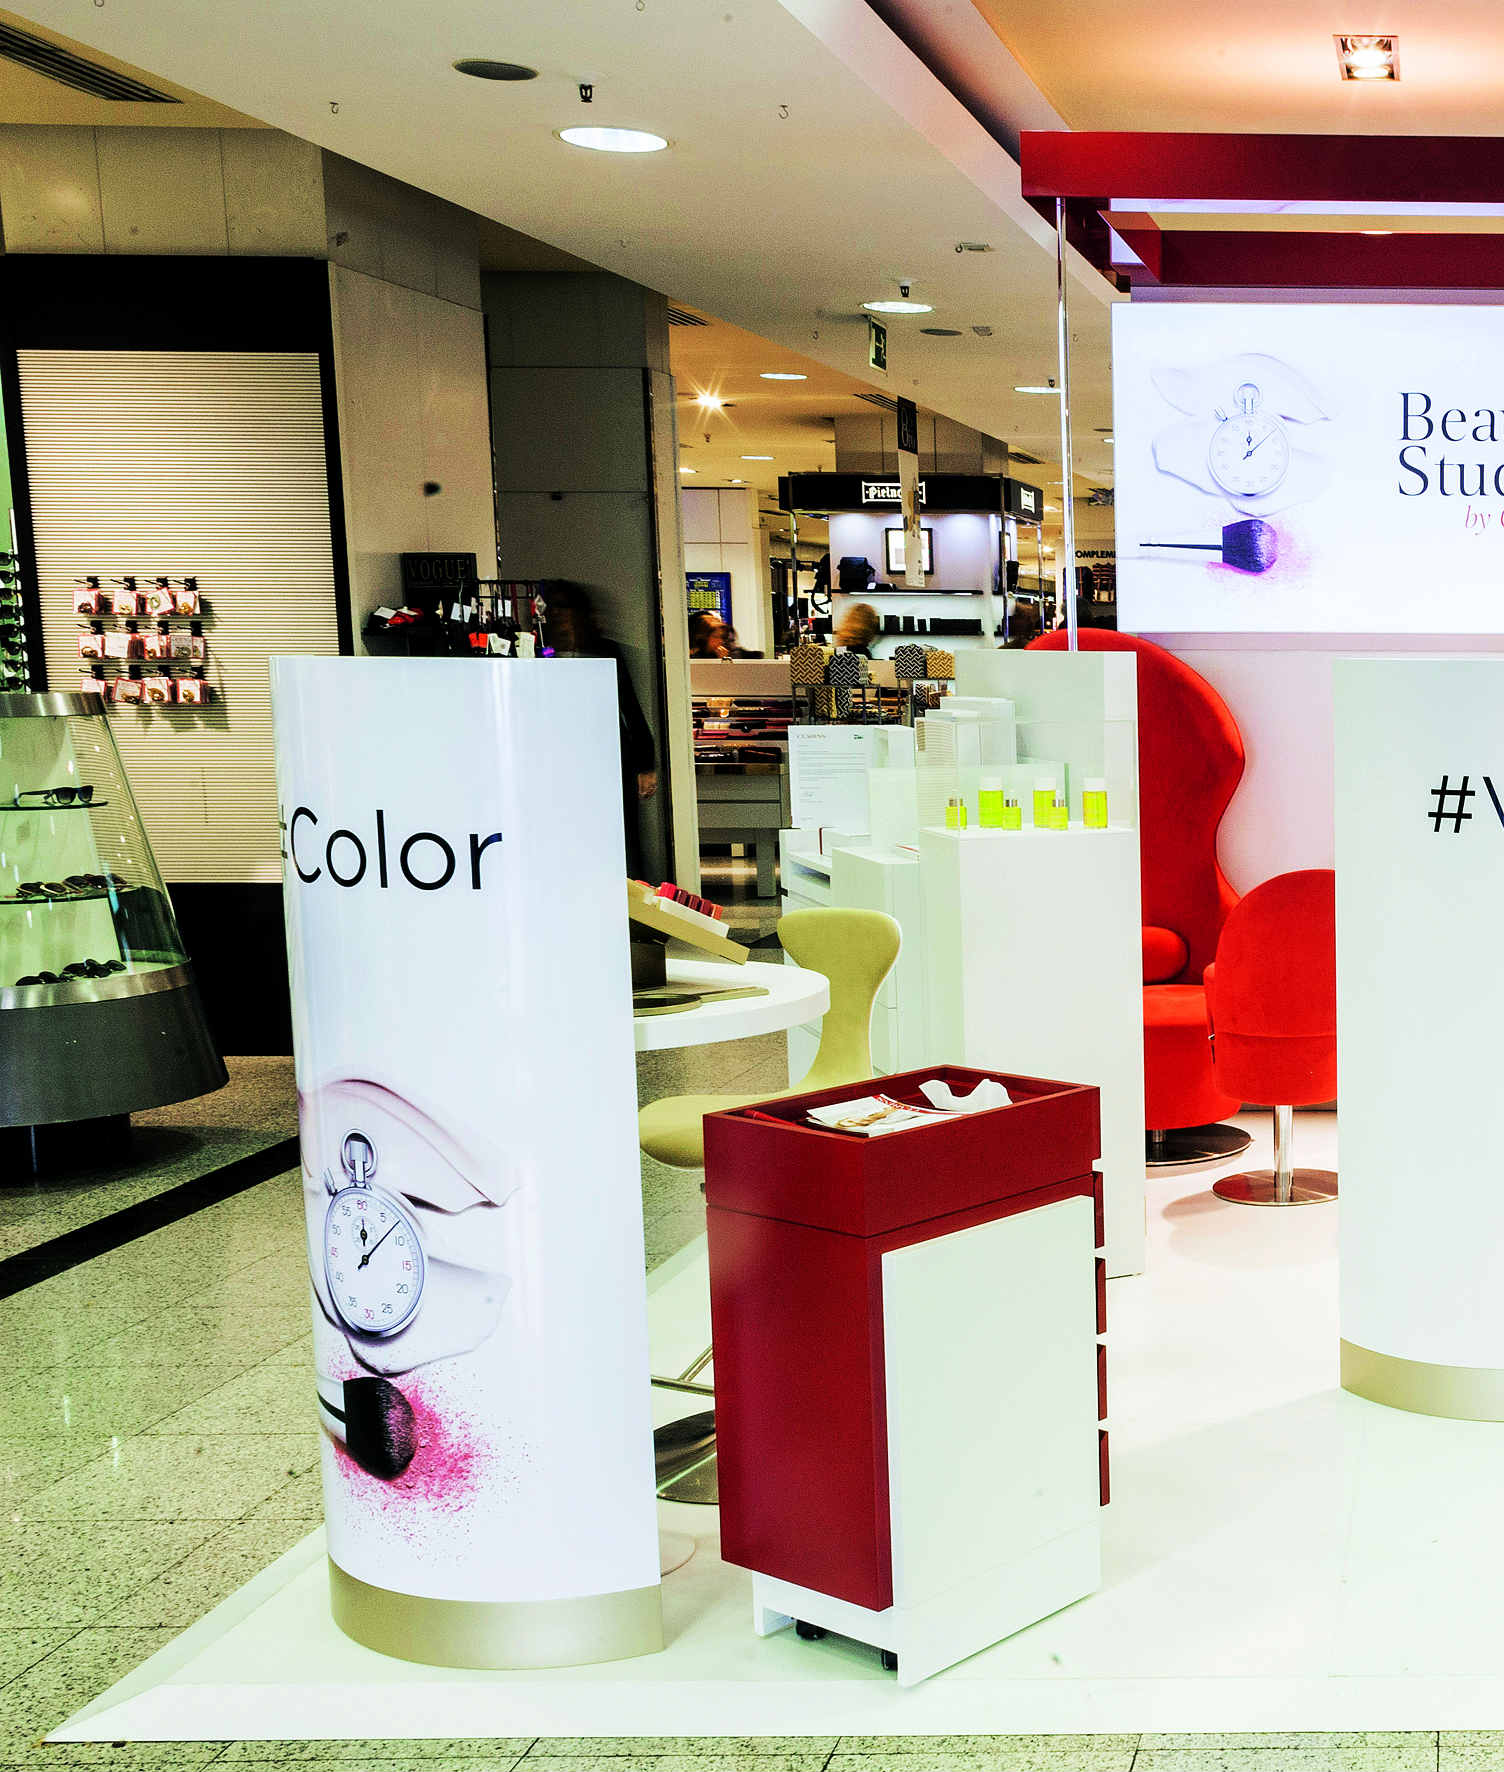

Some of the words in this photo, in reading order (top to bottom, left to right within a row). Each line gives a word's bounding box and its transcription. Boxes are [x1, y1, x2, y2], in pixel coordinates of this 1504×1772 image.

[1465, 504, 1491, 536] by
[1075, 550, 1116, 558] OMPLEM
[395, 1236, 405, 1247] 10
[401, 1260, 412, 1271] 15
[396, 1284, 408, 1294] 20
[381, 1304, 393, 1314] 25
